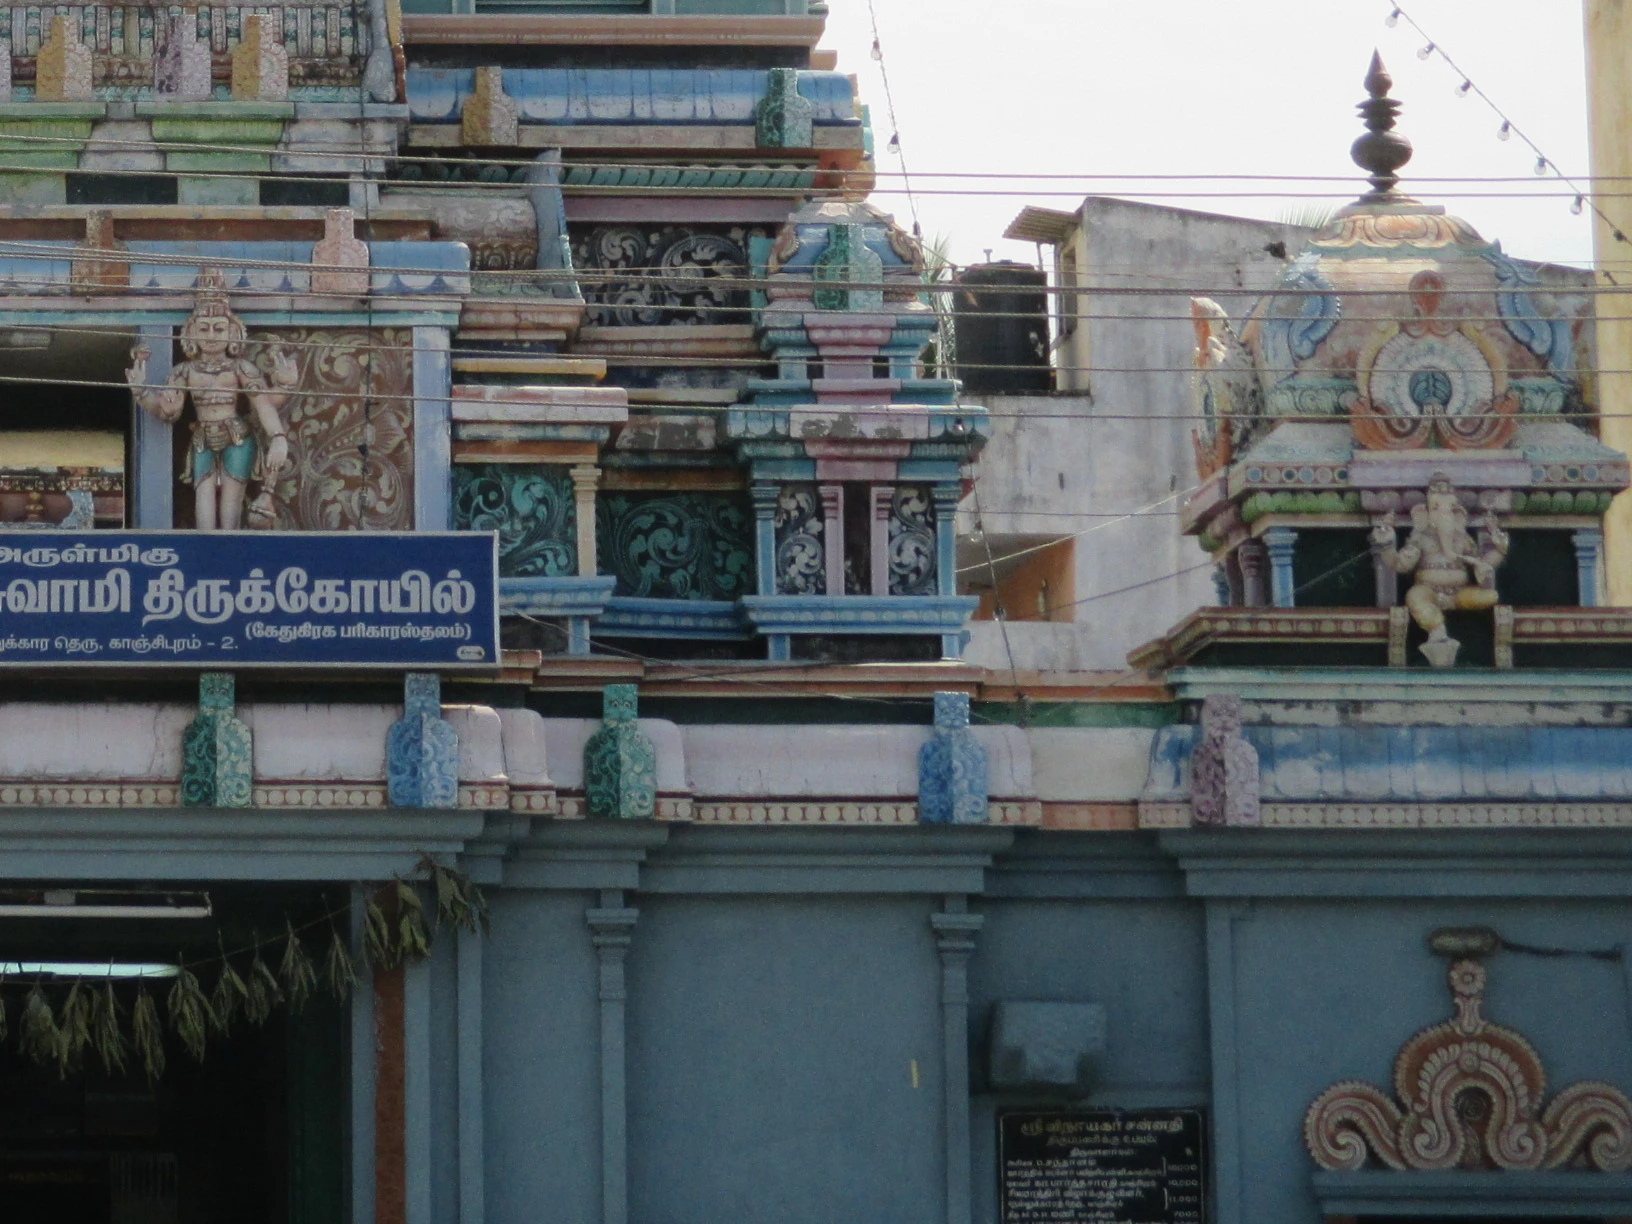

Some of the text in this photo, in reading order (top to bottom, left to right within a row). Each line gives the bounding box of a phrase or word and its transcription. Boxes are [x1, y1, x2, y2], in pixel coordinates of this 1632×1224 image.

[143, 566, 477, 626] திருக்கோயில்
[246, 621, 473, 644] (கேதுகிரக பரிகாரஸ்தலம்)
[54, 636, 104, 656] தெரு,
[108, 635, 202, 656] காஞ்சிபுரம்
